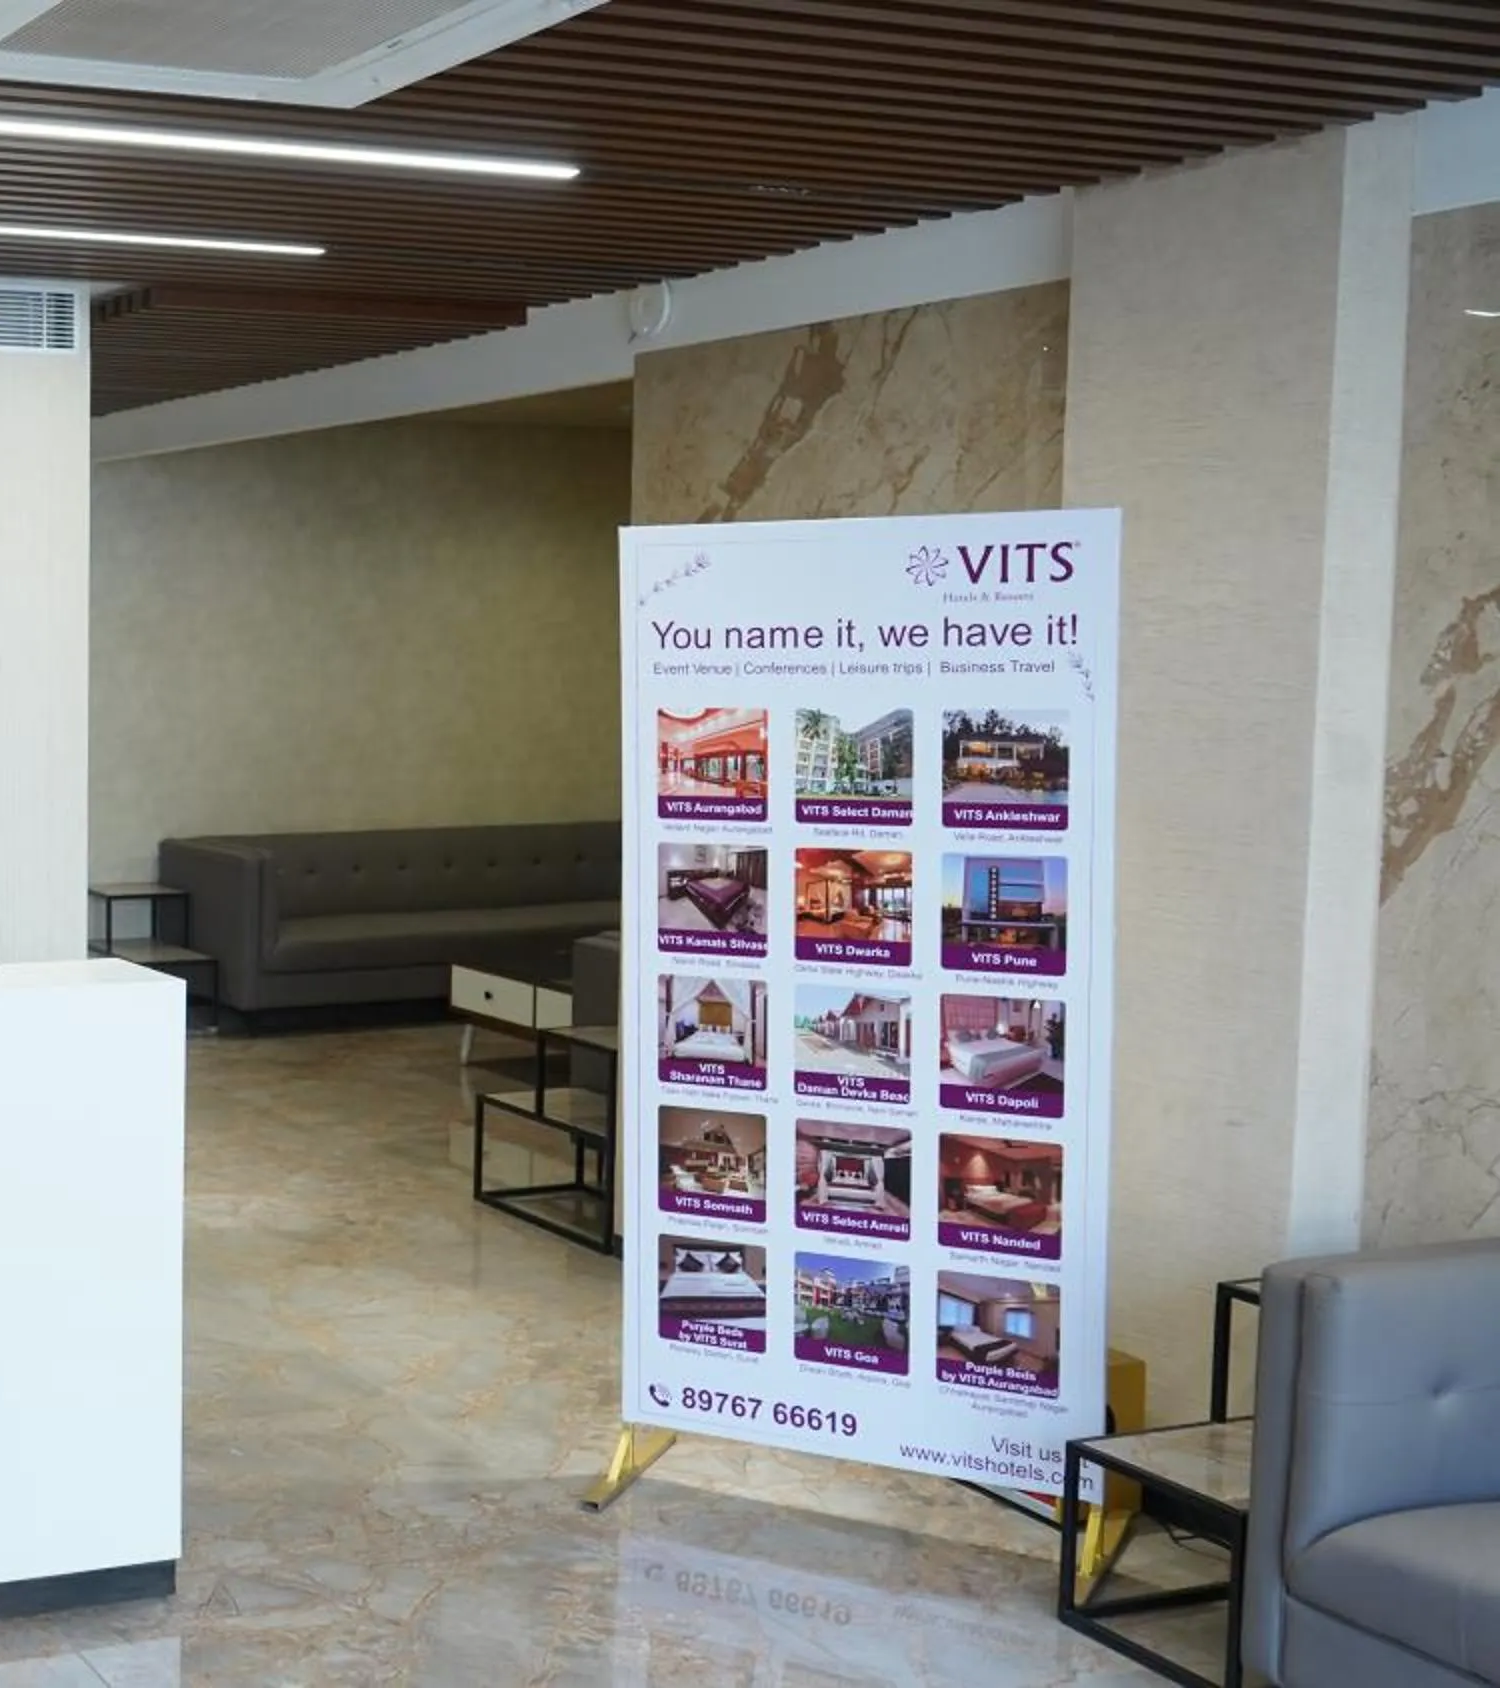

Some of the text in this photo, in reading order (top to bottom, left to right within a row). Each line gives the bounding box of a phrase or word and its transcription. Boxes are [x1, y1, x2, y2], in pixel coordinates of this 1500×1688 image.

[957, 541, 1074, 585] VITS
[651, 613, 1078, 653] You name it, we have it!
[653, 662, 690, 675] Event
[692, 662, 732, 675] Venue
[743, 660, 828, 676] Conferences
[839, 662, 889, 675] Leisure
[893, 661, 924, 677] trips
[940, 660, 1005, 674] Business
[1009, 659, 1055, 673] Travel
[665, 801, 763, 816] VITS Aurangabad
[801, 804, 829, 817] VITS
[832, 805, 869, 817] Select
[954, 809, 1061, 823] VITS Ankleshwar
[659, 934, 768, 951] VITS Kamats Silvass
[815, 943, 891, 958] VITS Dwarka
[971, 951, 1037, 967] VITS Pune
[669, 1070, 763, 1088] Sharanam Thane
[699, 1063, 726, 1075] VITS
[837, 1075, 865, 1088] VITS
[797, 1081, 839, 1096] Daman
[880, 1089, 910, 1103] Beac
[965, 1091, 1040, 1111] VITS Dapoli
[675, 1195, 754, 1216] VITS Somnath
[802, 1210, 909, 1235] VITS Select Amreli
[960, 1231, 1042, 1251] VITS Nanded
[680, 1319, 744, 1338] Purple Beds
[678, 1330, 748, 1350] by VITS Surat
[824, 1345, 880, 1365] VITS Goa
[964, 1361, 1037, 1382] Purple Beds
[941, 1369, 1059, 1397] by VITS Aurangabad
[681, 1386, 858, 1437] 89767 66619
[991, 1435, 1033, 1459] Visit
[1038, 1447, 1063, 1463] us
[899, 1443, 1095, 1492] www.vitshotels.cm
